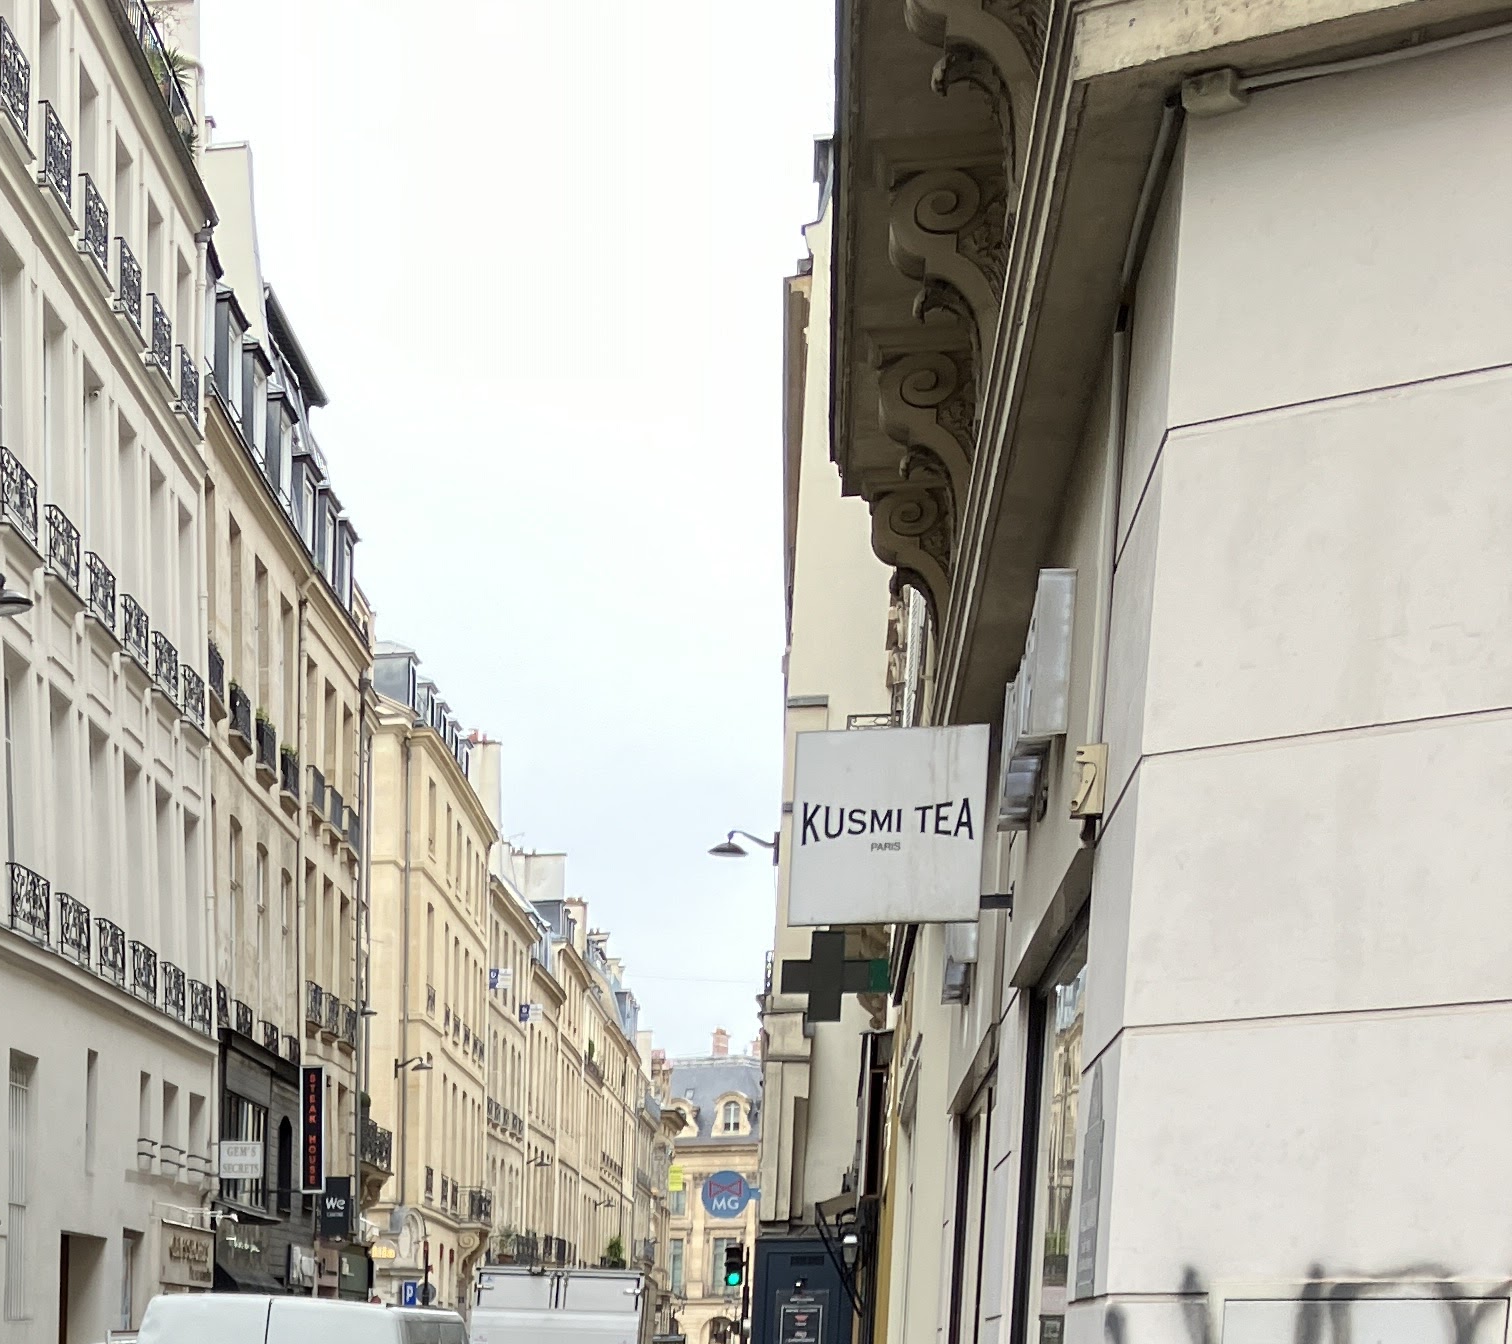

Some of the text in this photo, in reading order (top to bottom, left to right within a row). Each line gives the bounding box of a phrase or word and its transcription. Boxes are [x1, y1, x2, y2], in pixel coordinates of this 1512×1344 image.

[800, 797, 974, 846] KUSMI TEA
[870, 842, 901, 852] PARIS
[308, 1073, 317, 1185] STEAK HOUSE
[227, 1146, 257, 1158] GEM'S
[222, 1163, 259, 1175] SECRETS
[325, 1196, 346, 1210] We
[711, 1196, 740, 1211] MG
[406, 1285, 414, 1302] P
